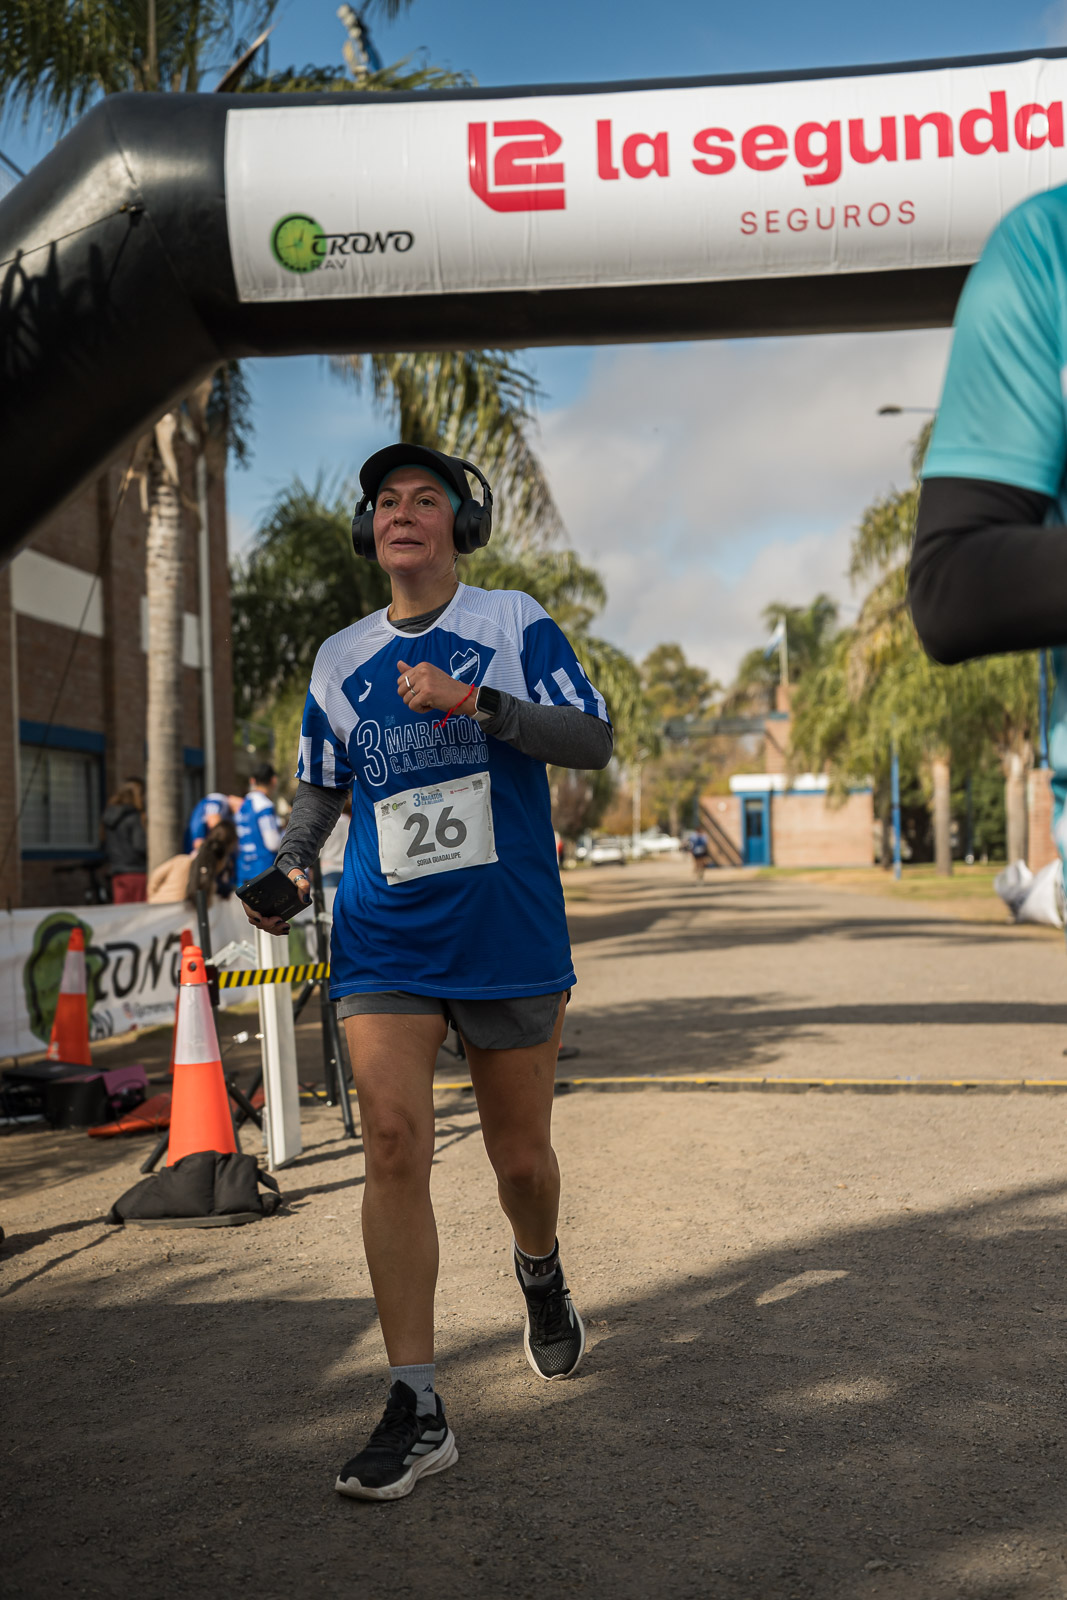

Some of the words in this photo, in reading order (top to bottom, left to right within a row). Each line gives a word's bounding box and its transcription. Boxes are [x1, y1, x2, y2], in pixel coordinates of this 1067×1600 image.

[596, 119, 670, 181] la
[691, 90, 1066, 187] segunda
[311, 231, 415, 255] CRONO
[740, 200, 917, 235] SEGUROS
[357, 720, 388, 787] 3
[403, 805, 468, 858] 26
[417, 857, 432, 867] SORIA
[432, 851, 462, 864] GUADALUPE
[84, 932, 182, 1001] RON
